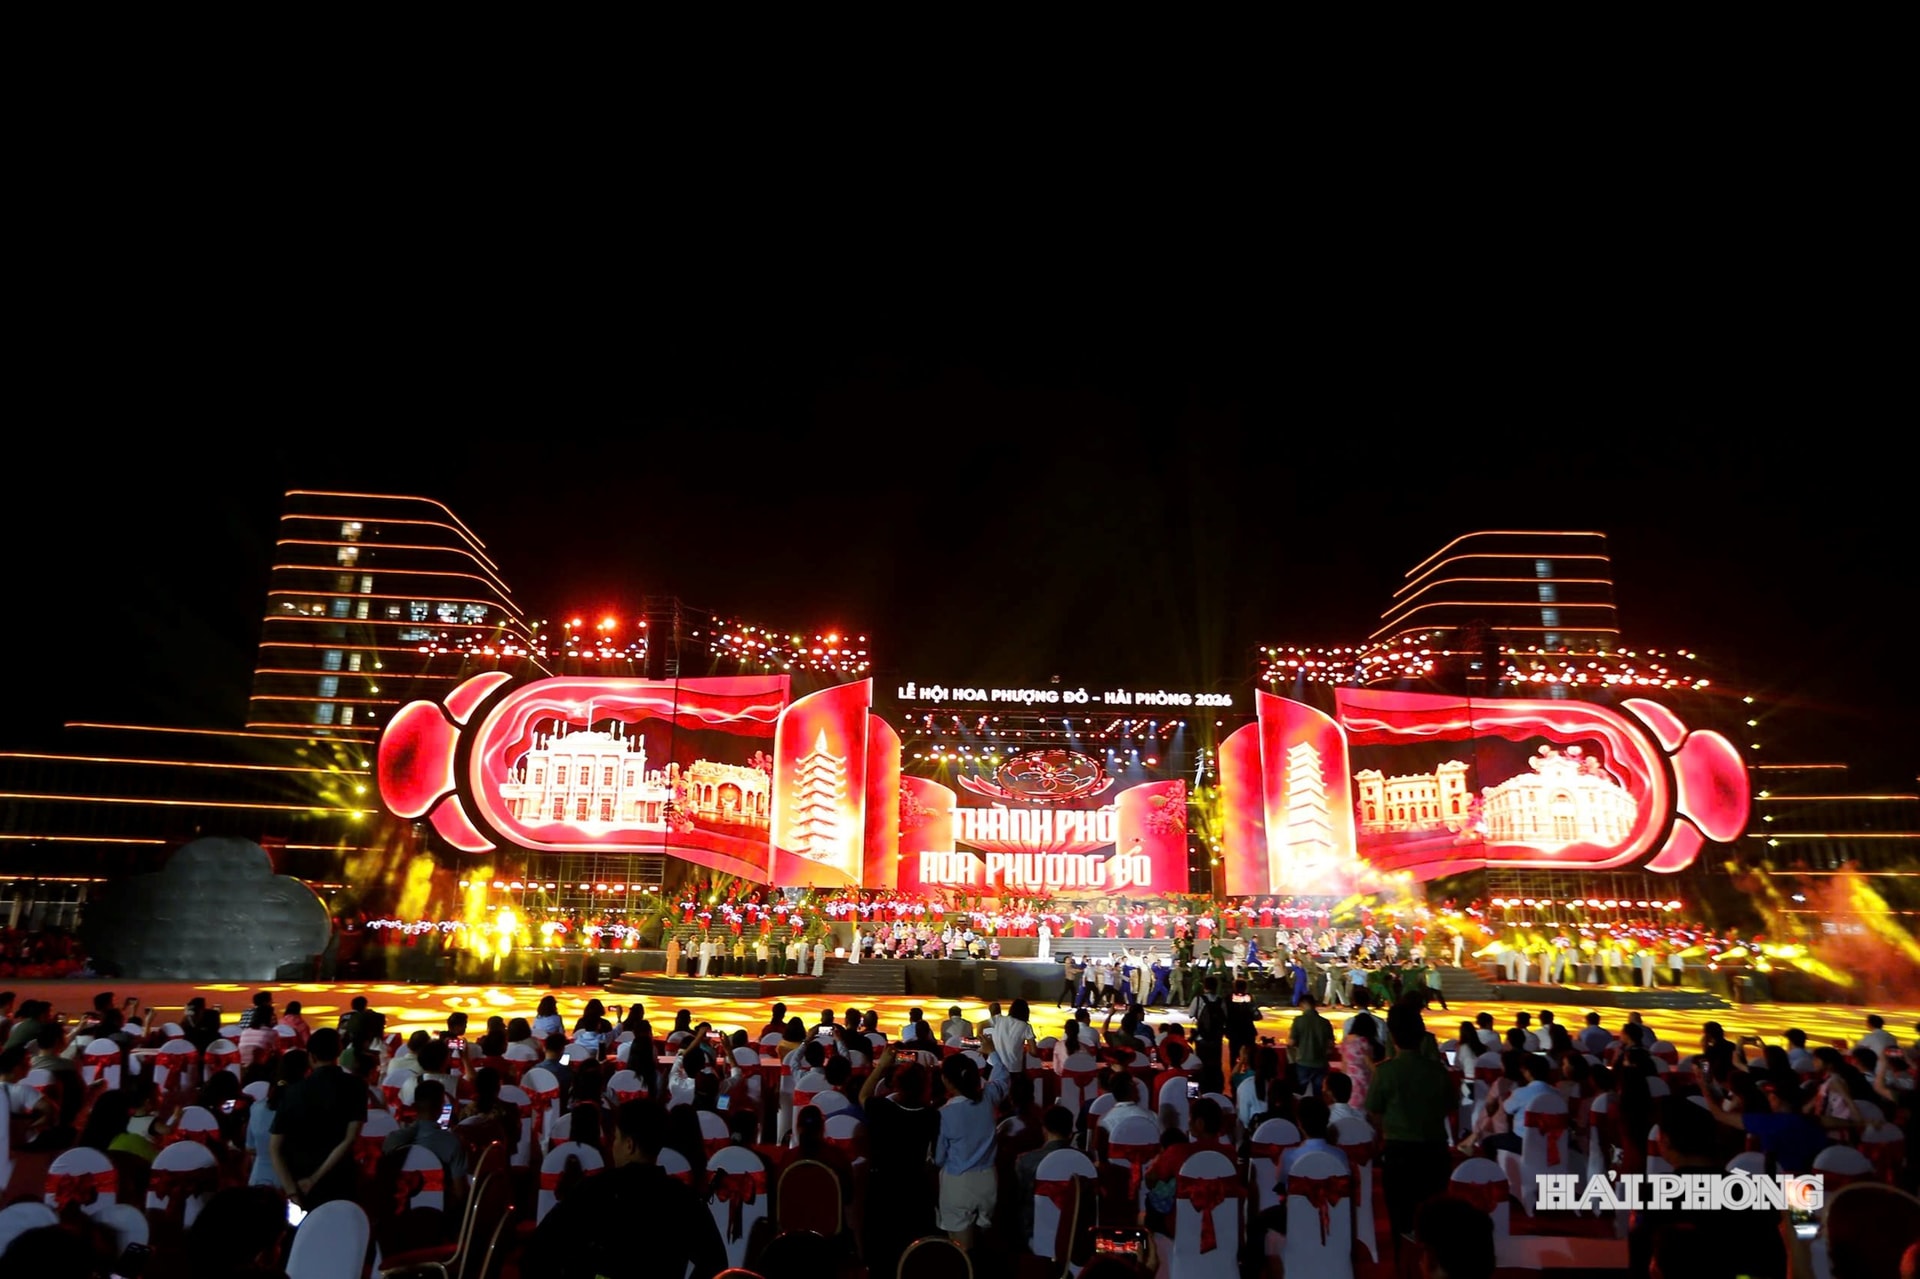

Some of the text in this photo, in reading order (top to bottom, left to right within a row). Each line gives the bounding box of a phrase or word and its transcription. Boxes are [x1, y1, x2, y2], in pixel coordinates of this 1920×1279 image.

[898, 682, 916, 700] LỄ
[919, 685, 949, 704] HỘI
[952, 688, 988, 701] HOA
[991, 688, 1059, 706] PHƯỢNG
[1063, 688, 1089, 704] ĐỎ
[1104, 689, 1132, 705] HẢI
[1135, 690, 1192, 706] PHÒNG
[1195, 694, 1233, 706] 2026
[948, 802, 1052, 842] THÀNH
[919, 851, 976, 884] HOA
